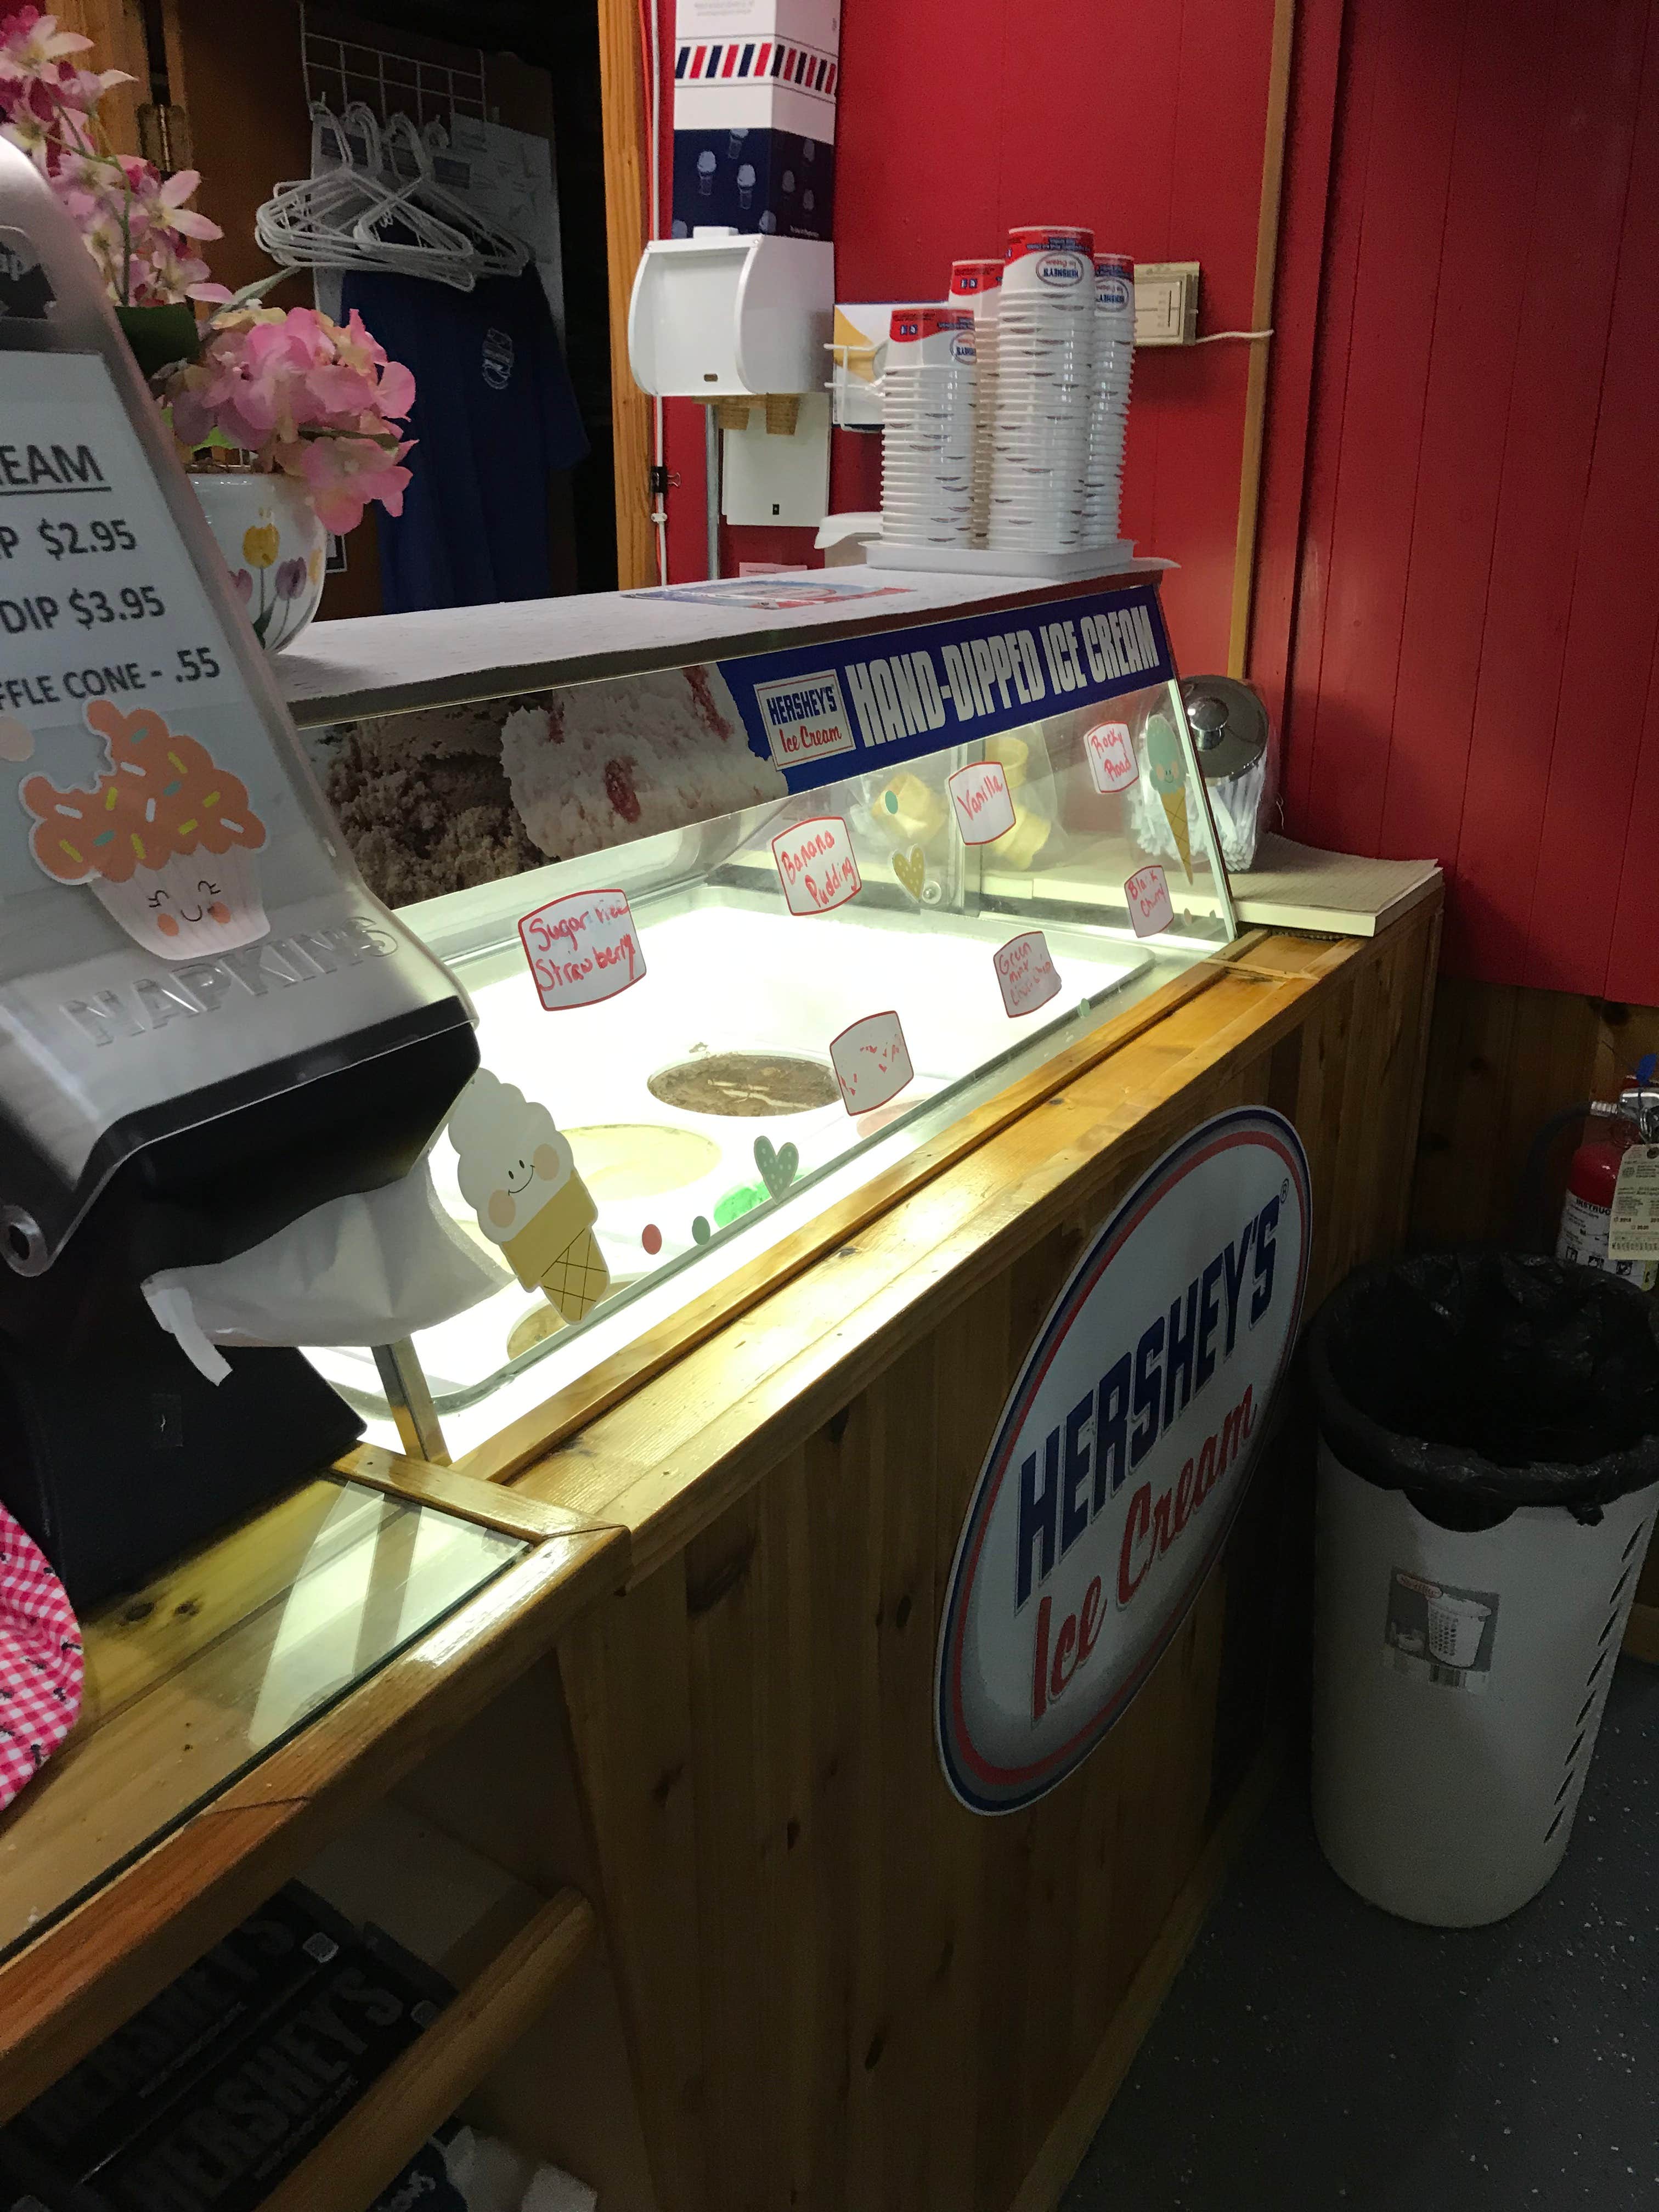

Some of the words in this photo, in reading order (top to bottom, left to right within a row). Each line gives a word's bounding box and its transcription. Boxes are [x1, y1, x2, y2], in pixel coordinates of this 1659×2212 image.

[0, 444, 105, 486] EAM
[0, 525, 19, 559] P
[37, 517, 137, 561] $2.95
[0, 596, 59, 634] DIP
[69, 585, 166, 630] $3.95
[63, 662, 146, 699] CONE
[175, 647, 220, 682] .55
[844, 629, 1046, 747] HAND-DIPPED
[1039, 620, 1087, 695] ICE
[1080, 606, 1160, 684] CREAM
[766, 686, 837, 725] HERSHEY'S
[779, 728, 800, 753] Ice
[800, 725, 842, 748] Cream
[1091, 727, 1126, 760] Rocky
[1104, 753, 1132, 782] Road
[957, 775, 1003, 821] Vanilla
[781, 830, 835, 885] Banana
[805, 856, 858, 909] Pudding
[529, 911, 589, 952] Sugar
[60, 916, 399, 1047] NAPKINS
[535, 933, 636, 992] Strawberry
[999, 942, 1032, 975] Green
[1015, 1195, 1280, 1613] HERSHEY'S
[1116, 1383, 1258, 1609] Cream
[1032, 1575, 1107, 1724] Ice
